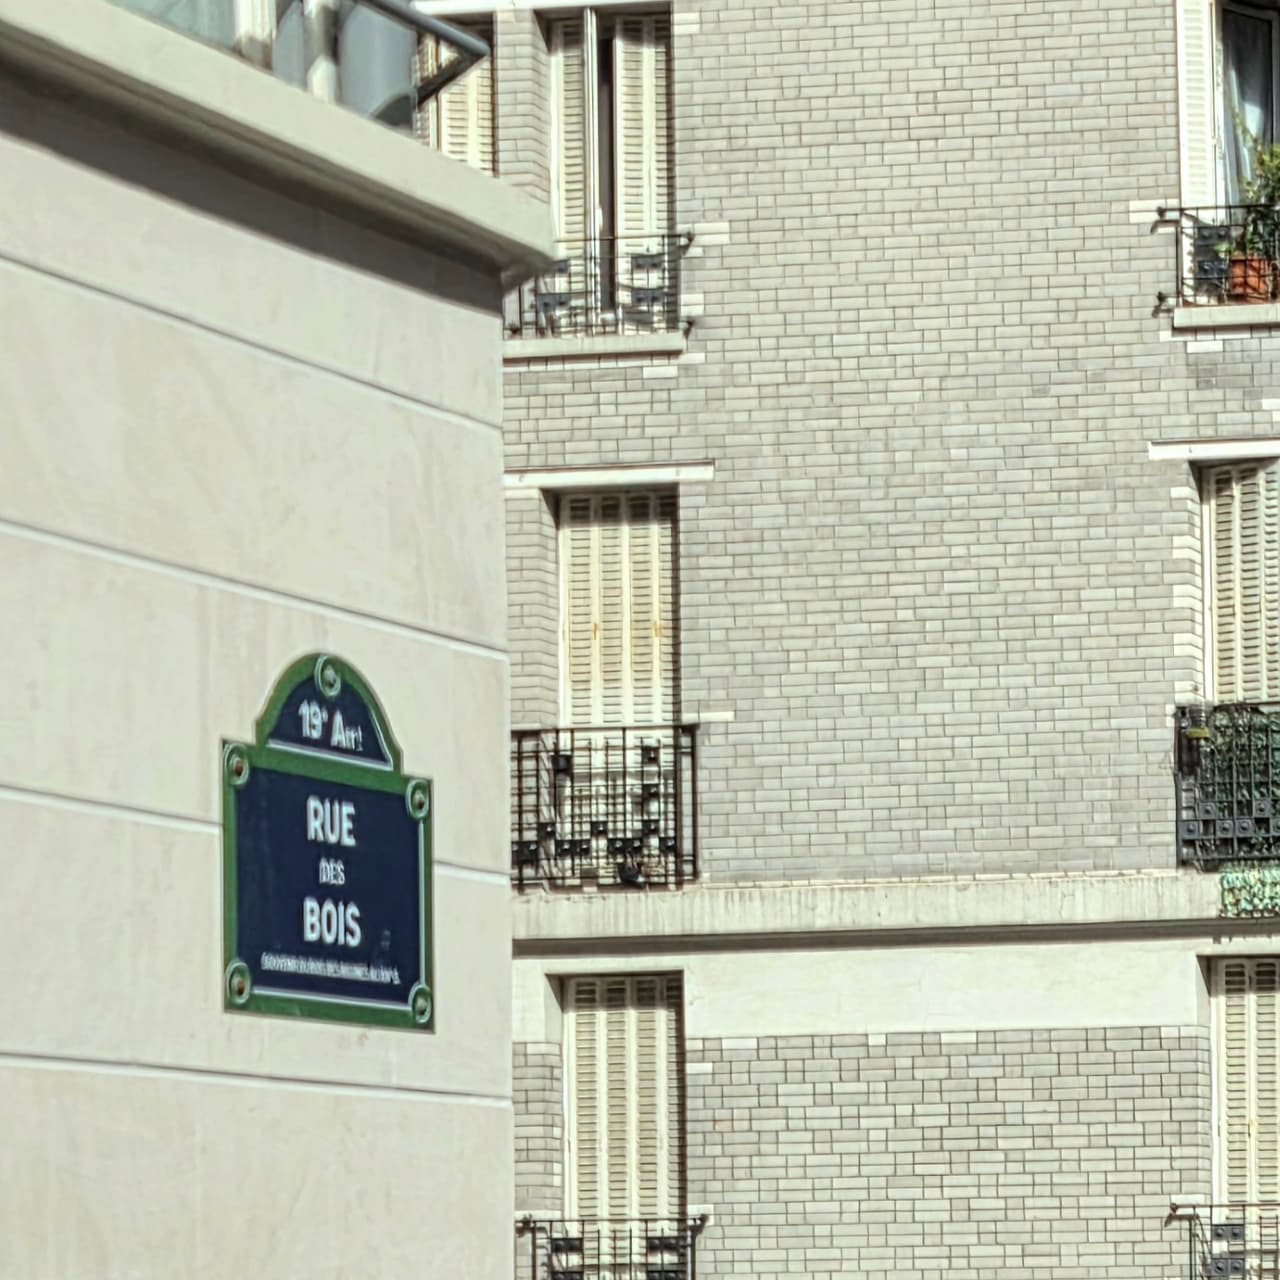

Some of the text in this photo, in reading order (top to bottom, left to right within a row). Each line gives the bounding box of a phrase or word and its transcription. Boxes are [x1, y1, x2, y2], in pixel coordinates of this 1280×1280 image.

[306, 794, 357, 847] RUE
[319, 857, 346, 885] DES
[303, 896, 362, 948] BOIS
